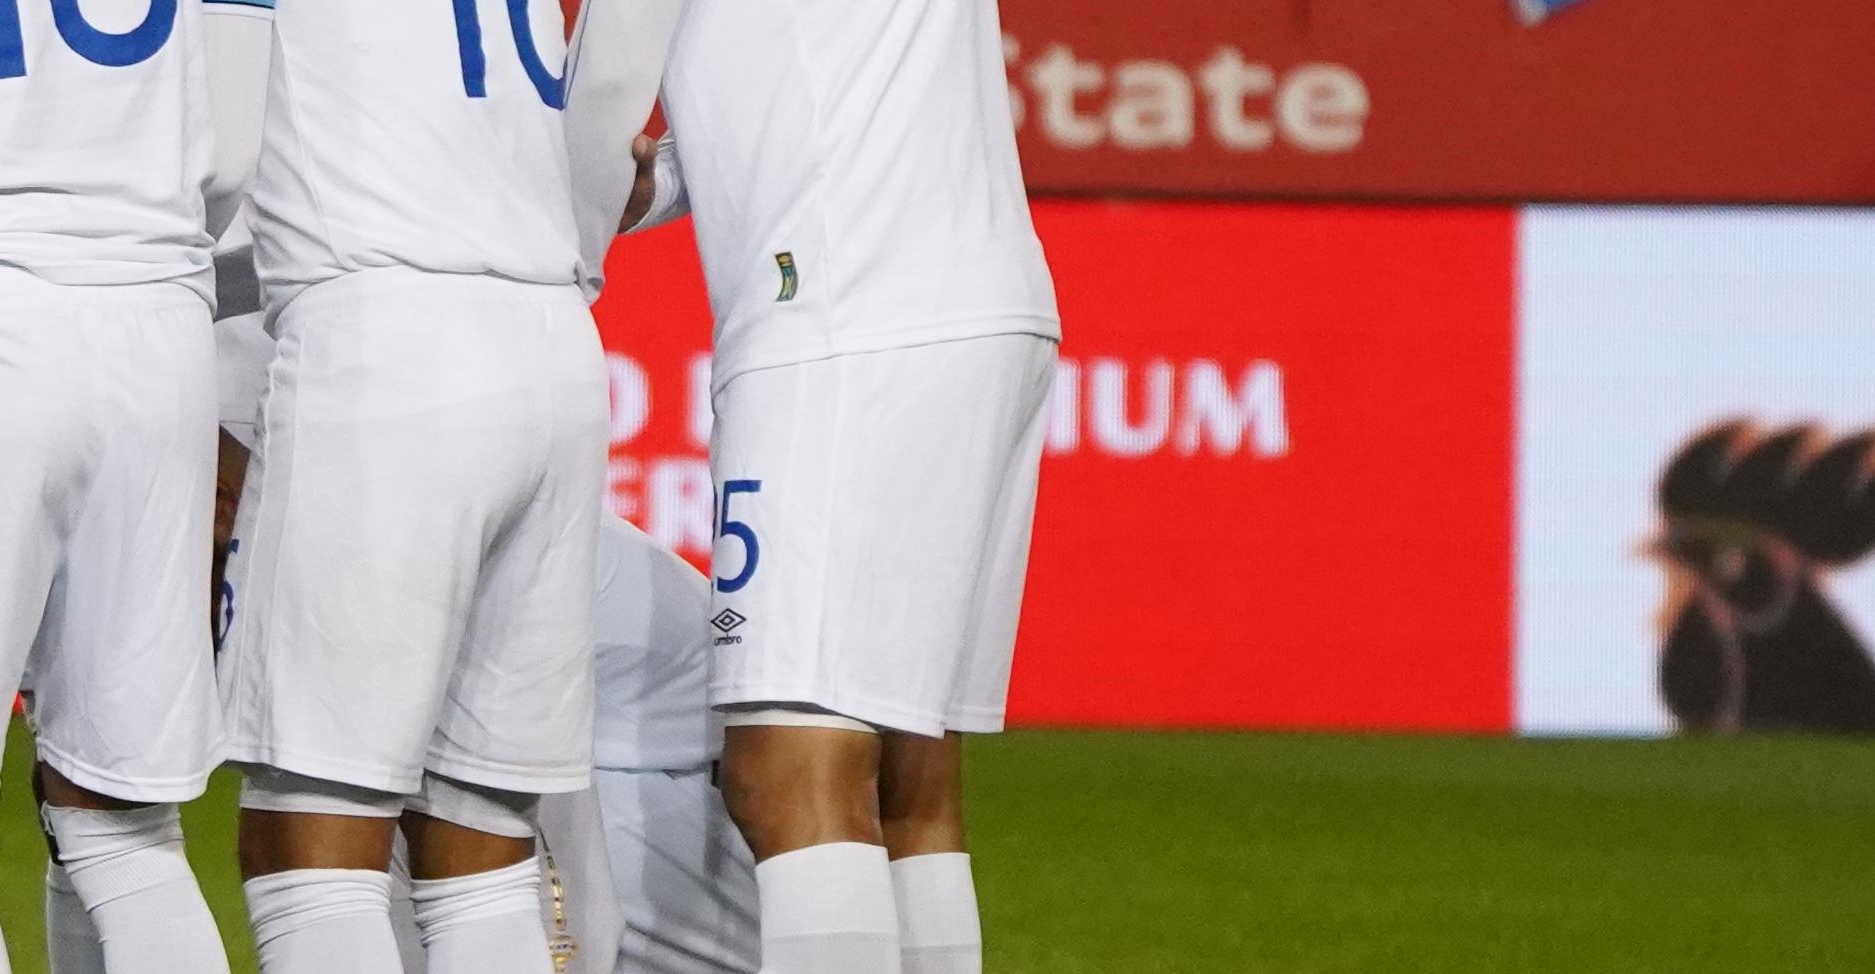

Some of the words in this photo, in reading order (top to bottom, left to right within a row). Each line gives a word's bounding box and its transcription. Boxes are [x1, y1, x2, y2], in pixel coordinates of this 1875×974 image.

[1001, 34, 1371, 152] tate
[712, 479, 763, 594] 5
[714, 634, 743, 647] umbro
